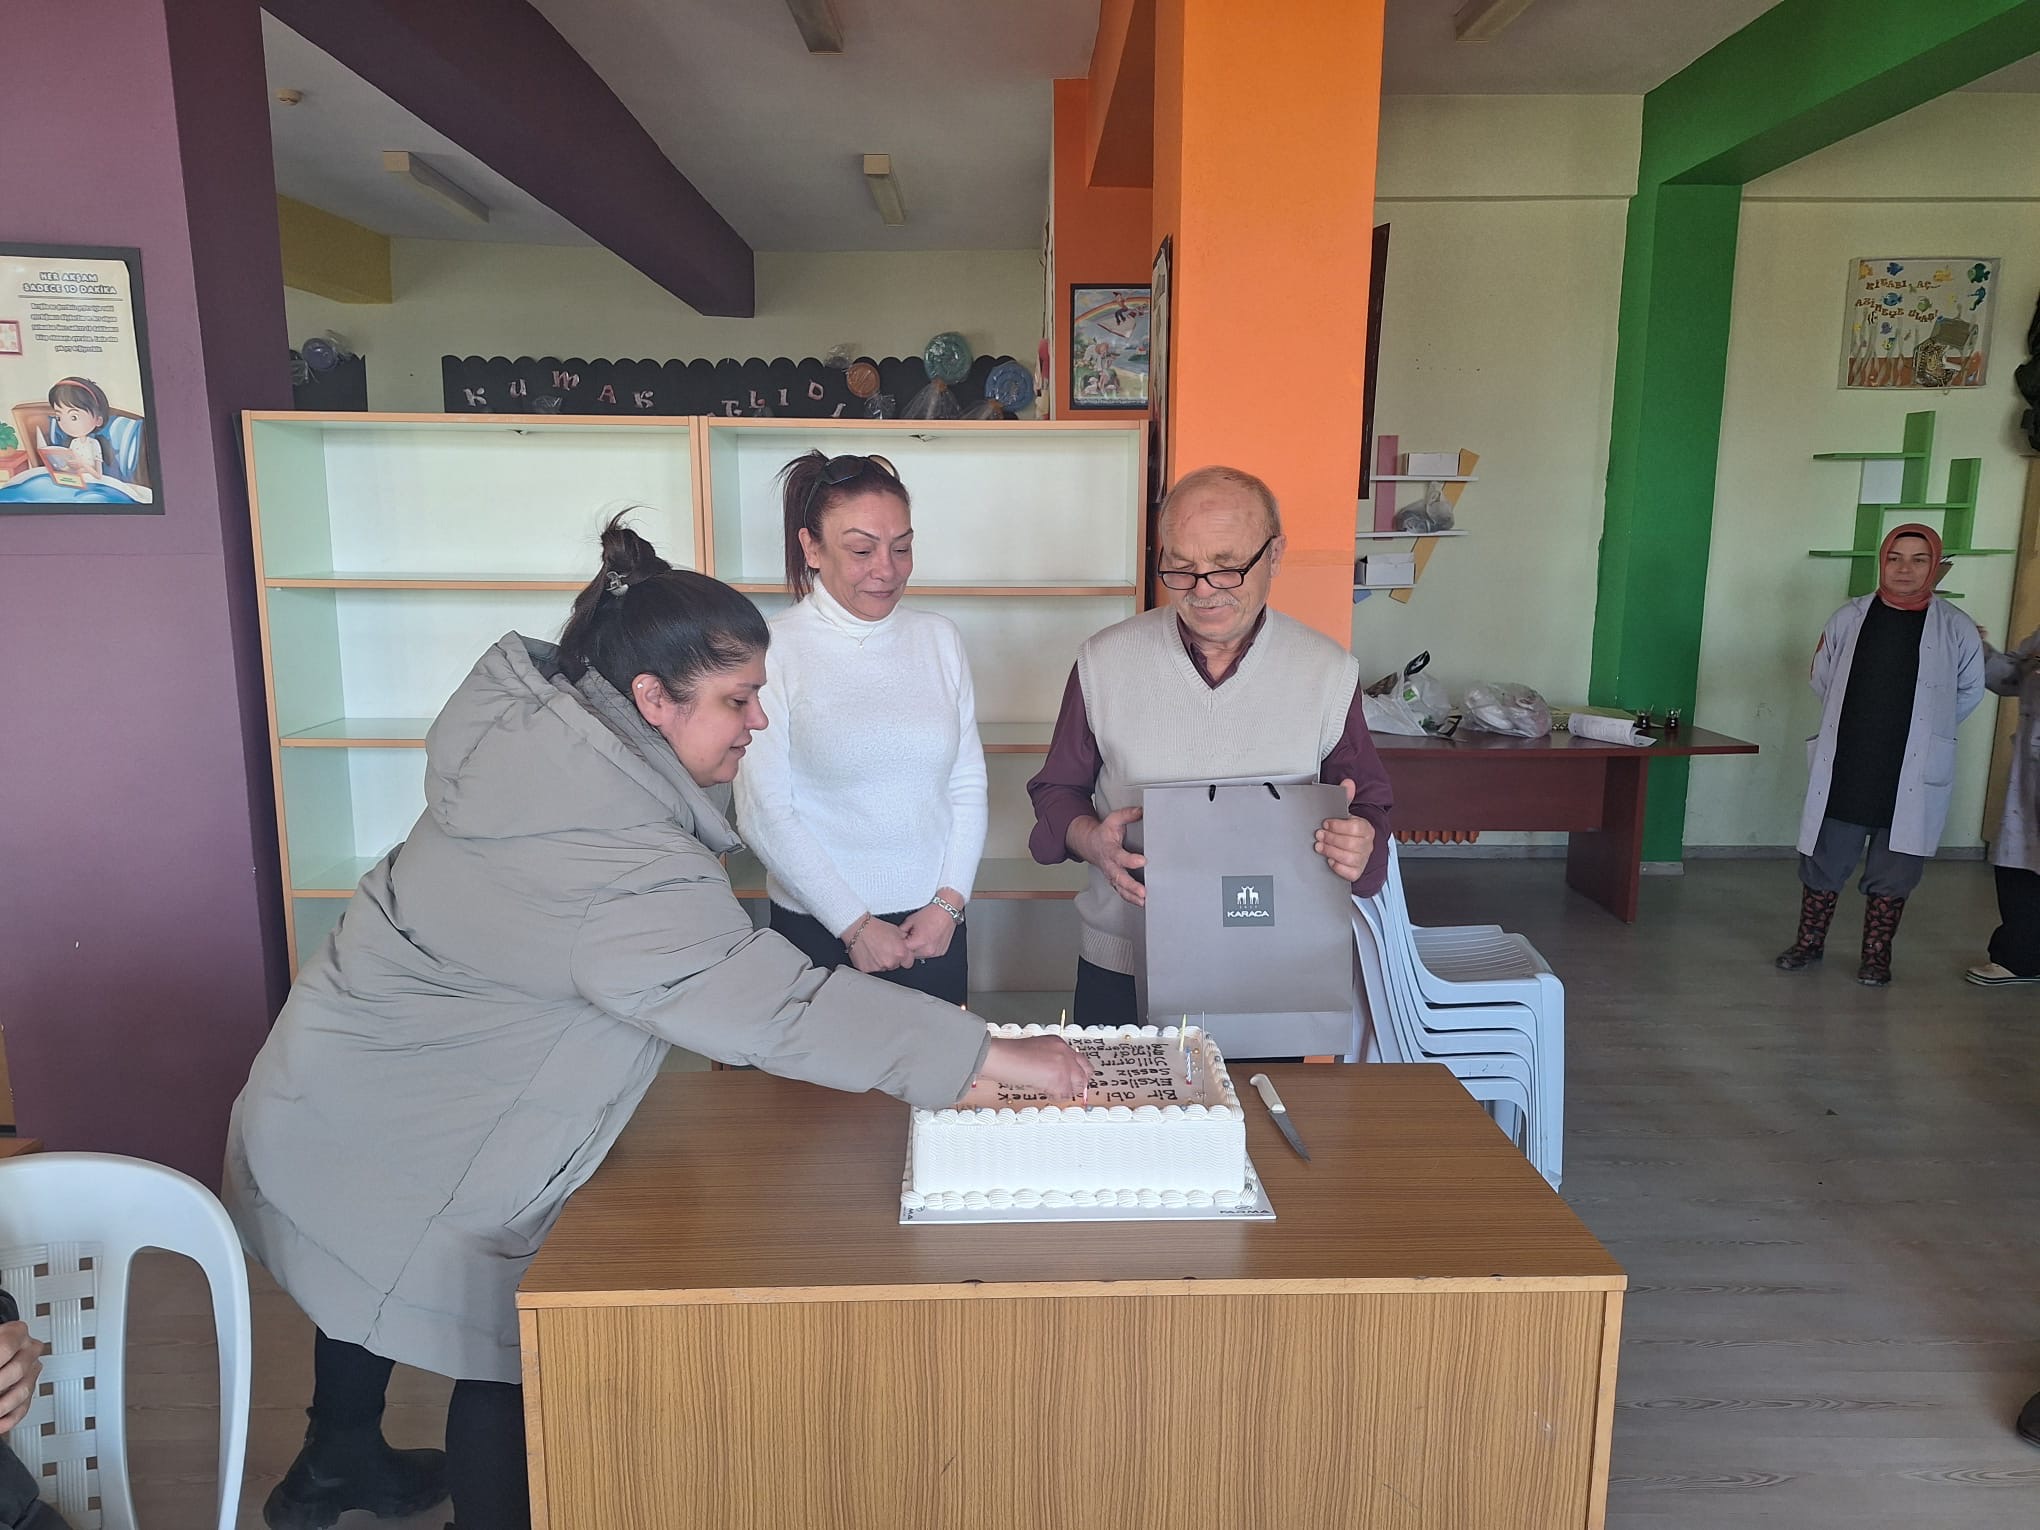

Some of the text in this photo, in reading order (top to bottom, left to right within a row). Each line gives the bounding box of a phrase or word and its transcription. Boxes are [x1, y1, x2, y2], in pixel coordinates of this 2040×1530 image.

[40, 272, 98, 283] HER AKŞAM
[23, 283, 117, 295] SADECE 10 DAKİKA
[1227, 910, 1270, 918] KARACA
[1116, 1068, 1171, 1078] Sessiz
[1147, 1089, 1178, 1101] Bir
